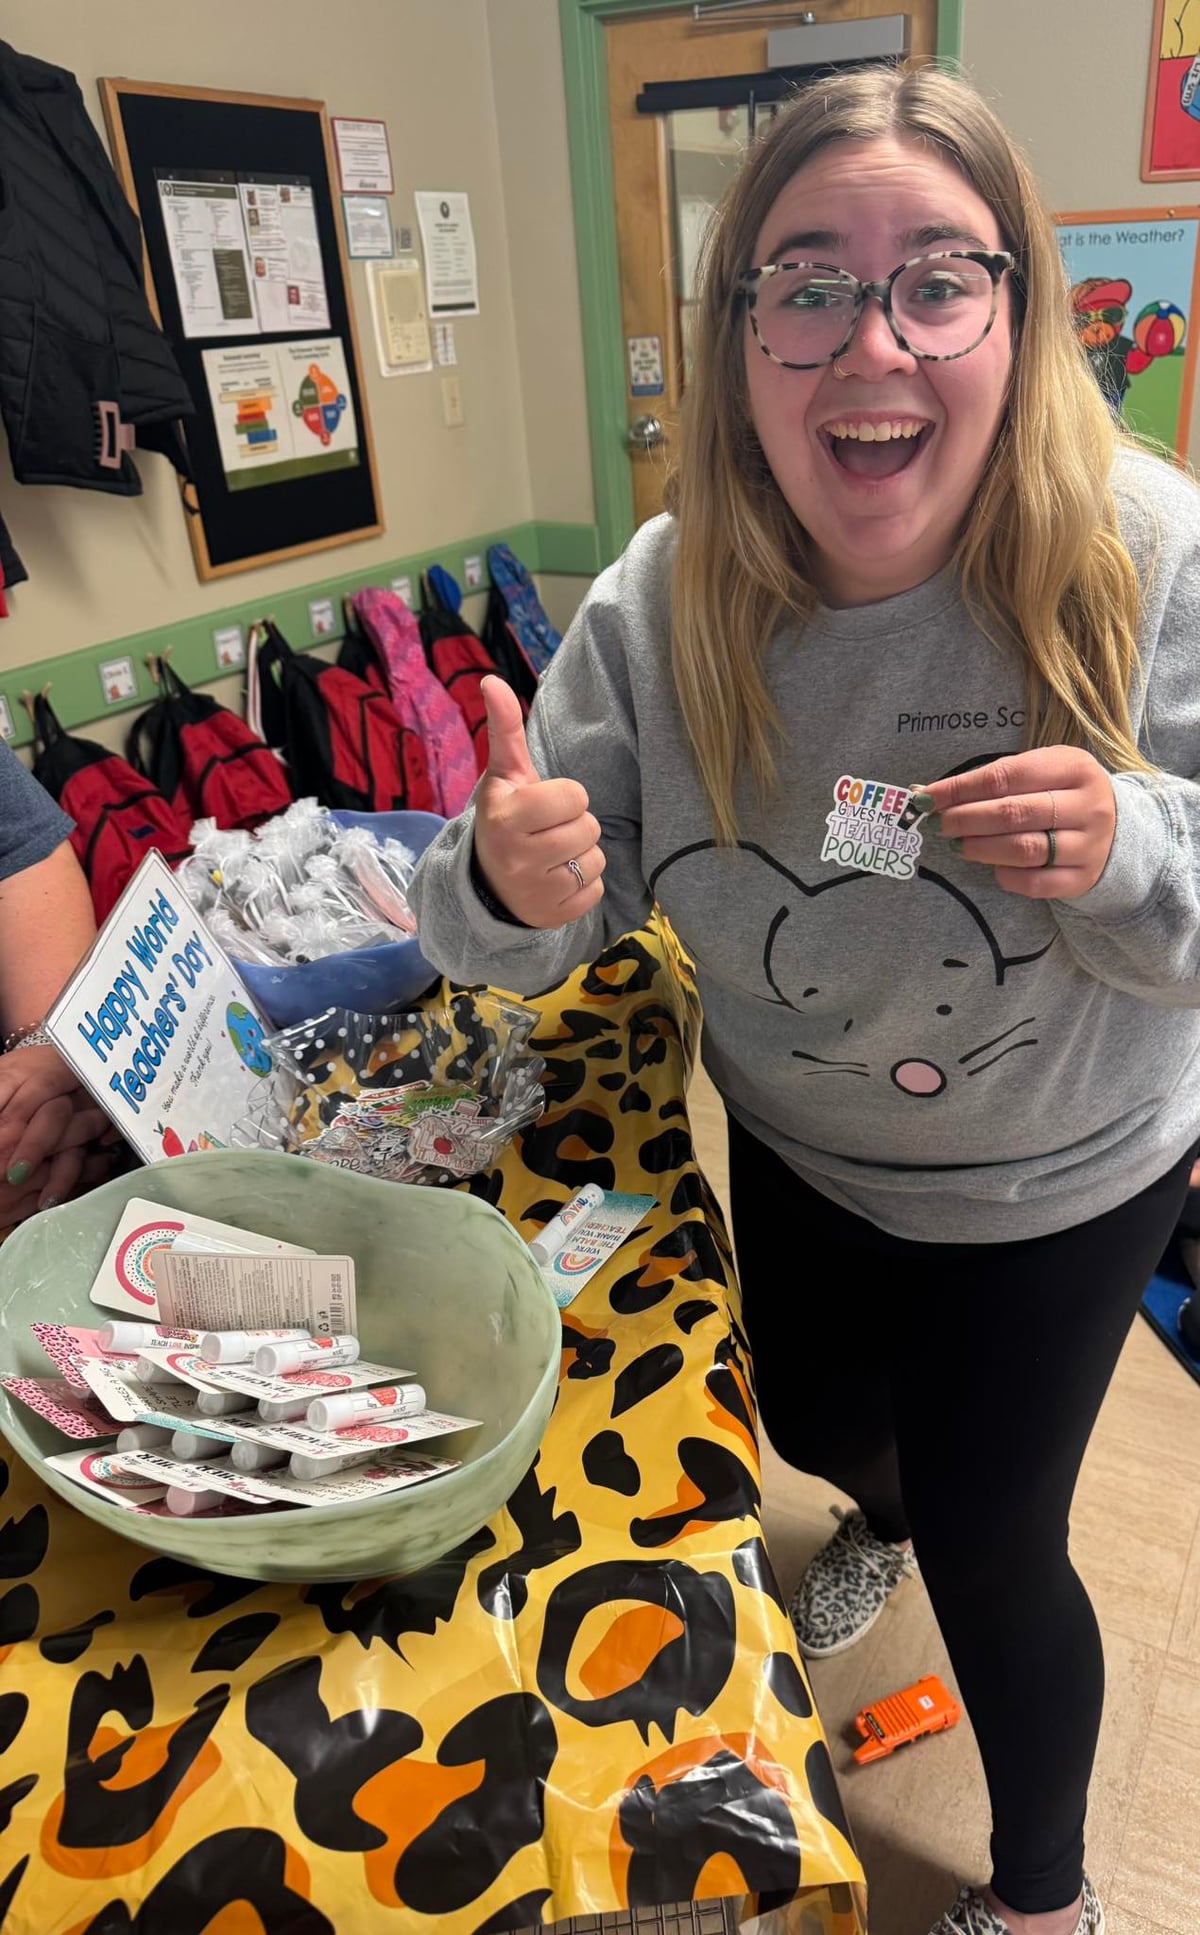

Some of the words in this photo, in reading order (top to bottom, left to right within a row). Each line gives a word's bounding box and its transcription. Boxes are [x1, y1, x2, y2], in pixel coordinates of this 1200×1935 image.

[1059, 233, 1073, 247] at
[1075, 232, 1084, 247] is
[1088, 230, 1112, 245] the
[1116, 228, 1185, 244] Weather?
[897, 712, 988, 733] Primrose
[996, 706, 1026, 728] Sc
[837, 778, 907, 814] COFFEE
[838, 800, 877, 823] GIVES
[877, 811, 895, 827] ME
[829, 816, 921, 854] TEACHER
[824, 836, 914, 877] POWERS
[77, 958, 150, 1064] Happy
[125, 887, 180, 974] World
[108, 972, 188, 1115] Teachers'
[171, 929, 213, 990] Day
[151, 1338, 169, 1347] TEACH
